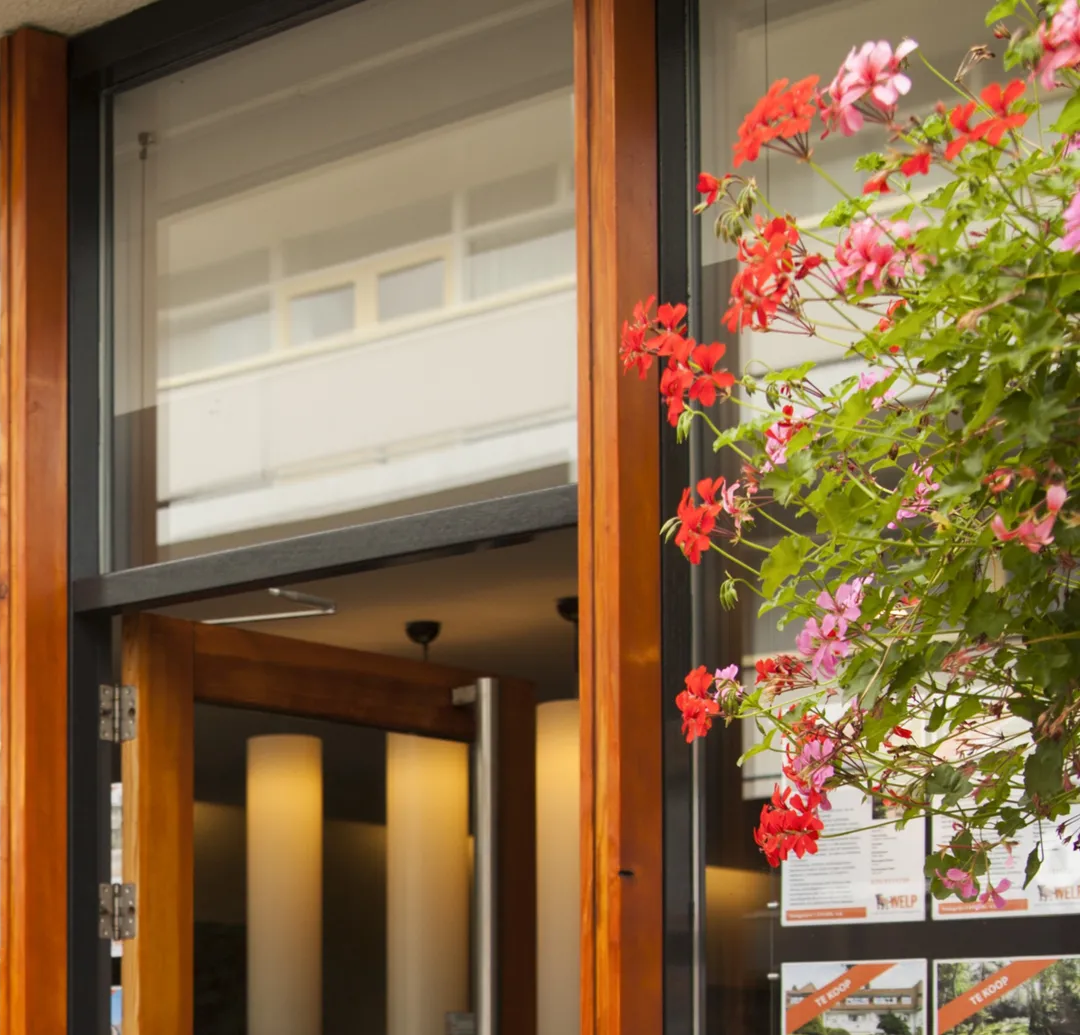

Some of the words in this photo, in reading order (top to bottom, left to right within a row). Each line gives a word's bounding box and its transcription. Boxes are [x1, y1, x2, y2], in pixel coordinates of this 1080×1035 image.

[890, 895, 917, 908] WELP
[815, 995, 827, 1007] TE
[827, 979, 851, 1000] KOOP
[969, 992, 983, 1005] TE
[981, 975, 1008, 997] KOOP
